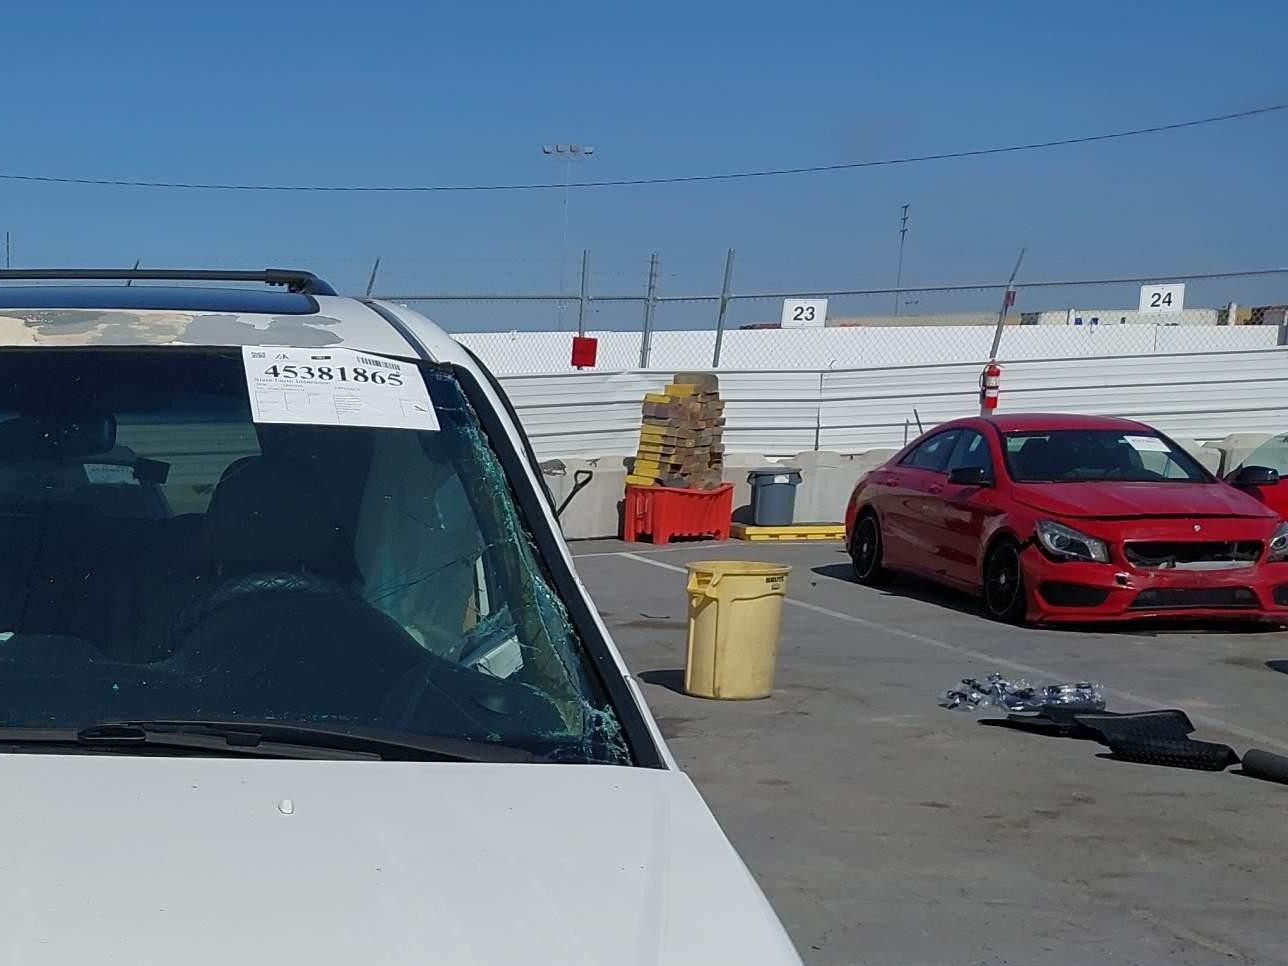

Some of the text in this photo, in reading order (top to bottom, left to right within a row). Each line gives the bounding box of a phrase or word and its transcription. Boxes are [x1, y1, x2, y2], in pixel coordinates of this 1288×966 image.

[1150, 291, 1173, 308] 24
[792, 306, 816, 321] 23
[264, 364, 404, 387] 45381865
